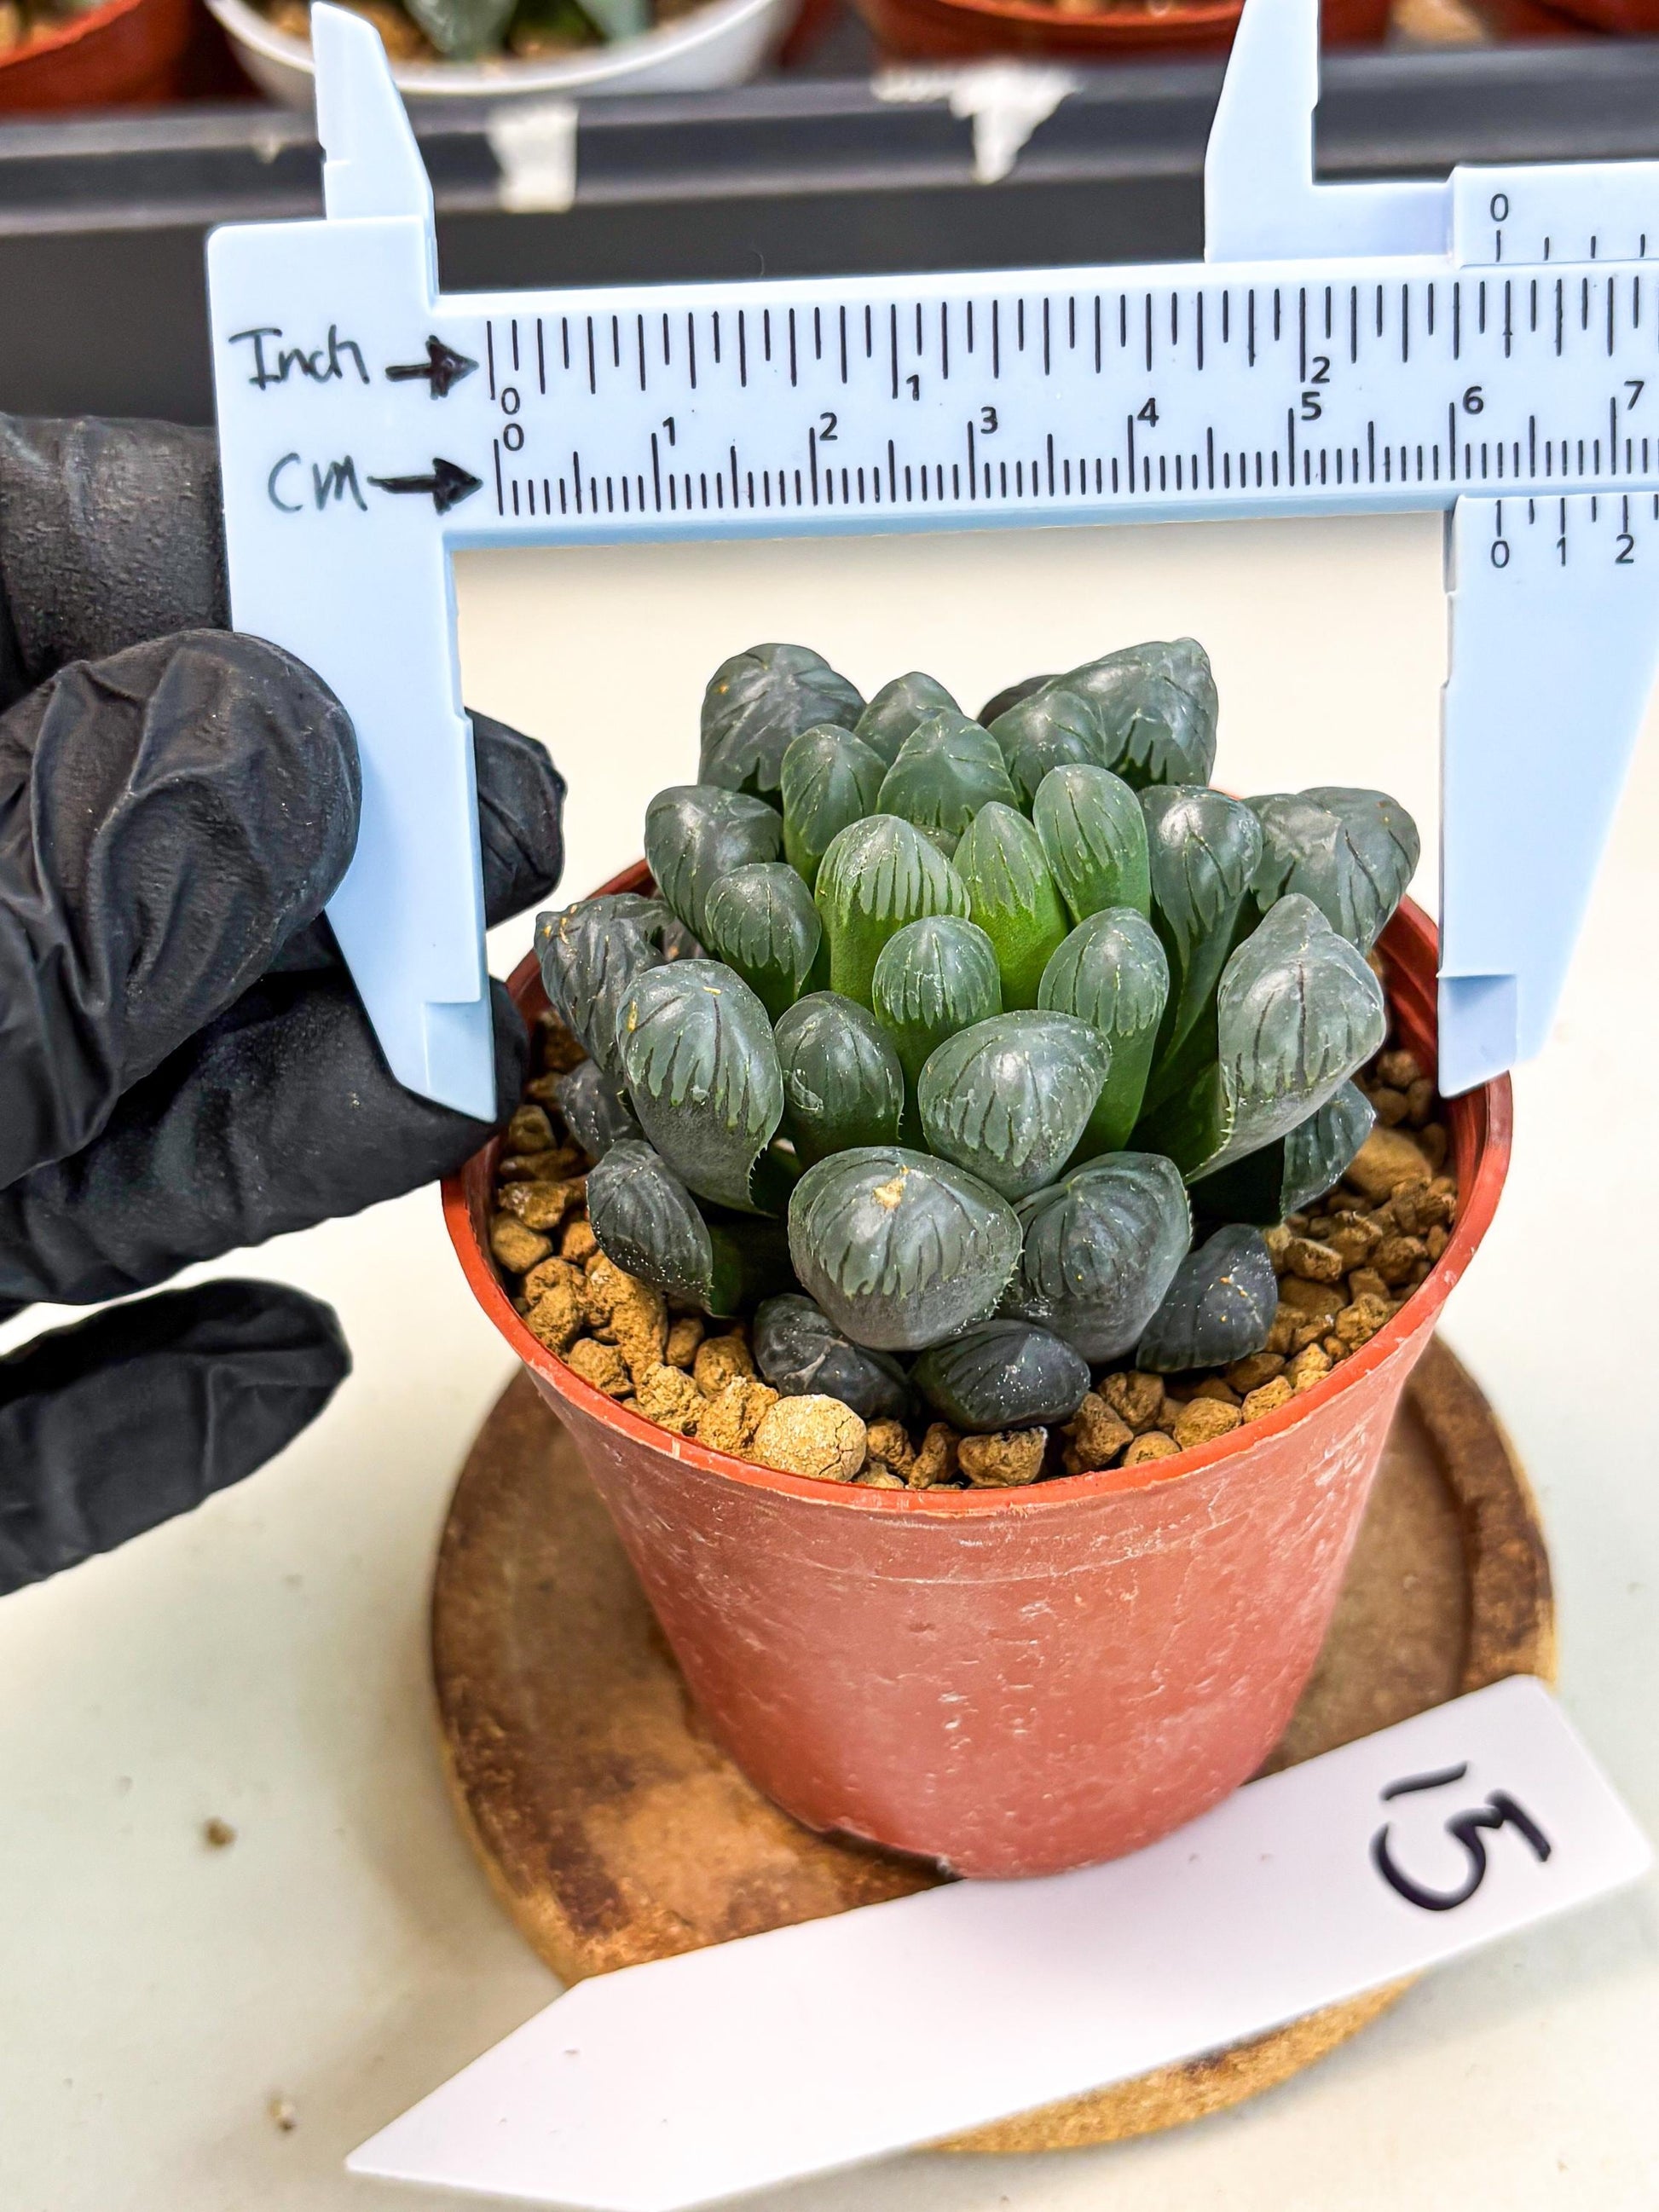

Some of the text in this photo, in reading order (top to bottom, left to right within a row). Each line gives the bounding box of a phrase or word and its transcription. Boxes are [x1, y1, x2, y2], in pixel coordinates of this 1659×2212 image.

[1489, 193, 1510, 222] 0
[228, 324, 371, 391] Inch
[500, 355, 1332, 416] 0 1 2
[502, 379, 1645, 452] 0 1 2 3 4 5 6 7
[1490, 533, 1635, 569] 0 1 2
